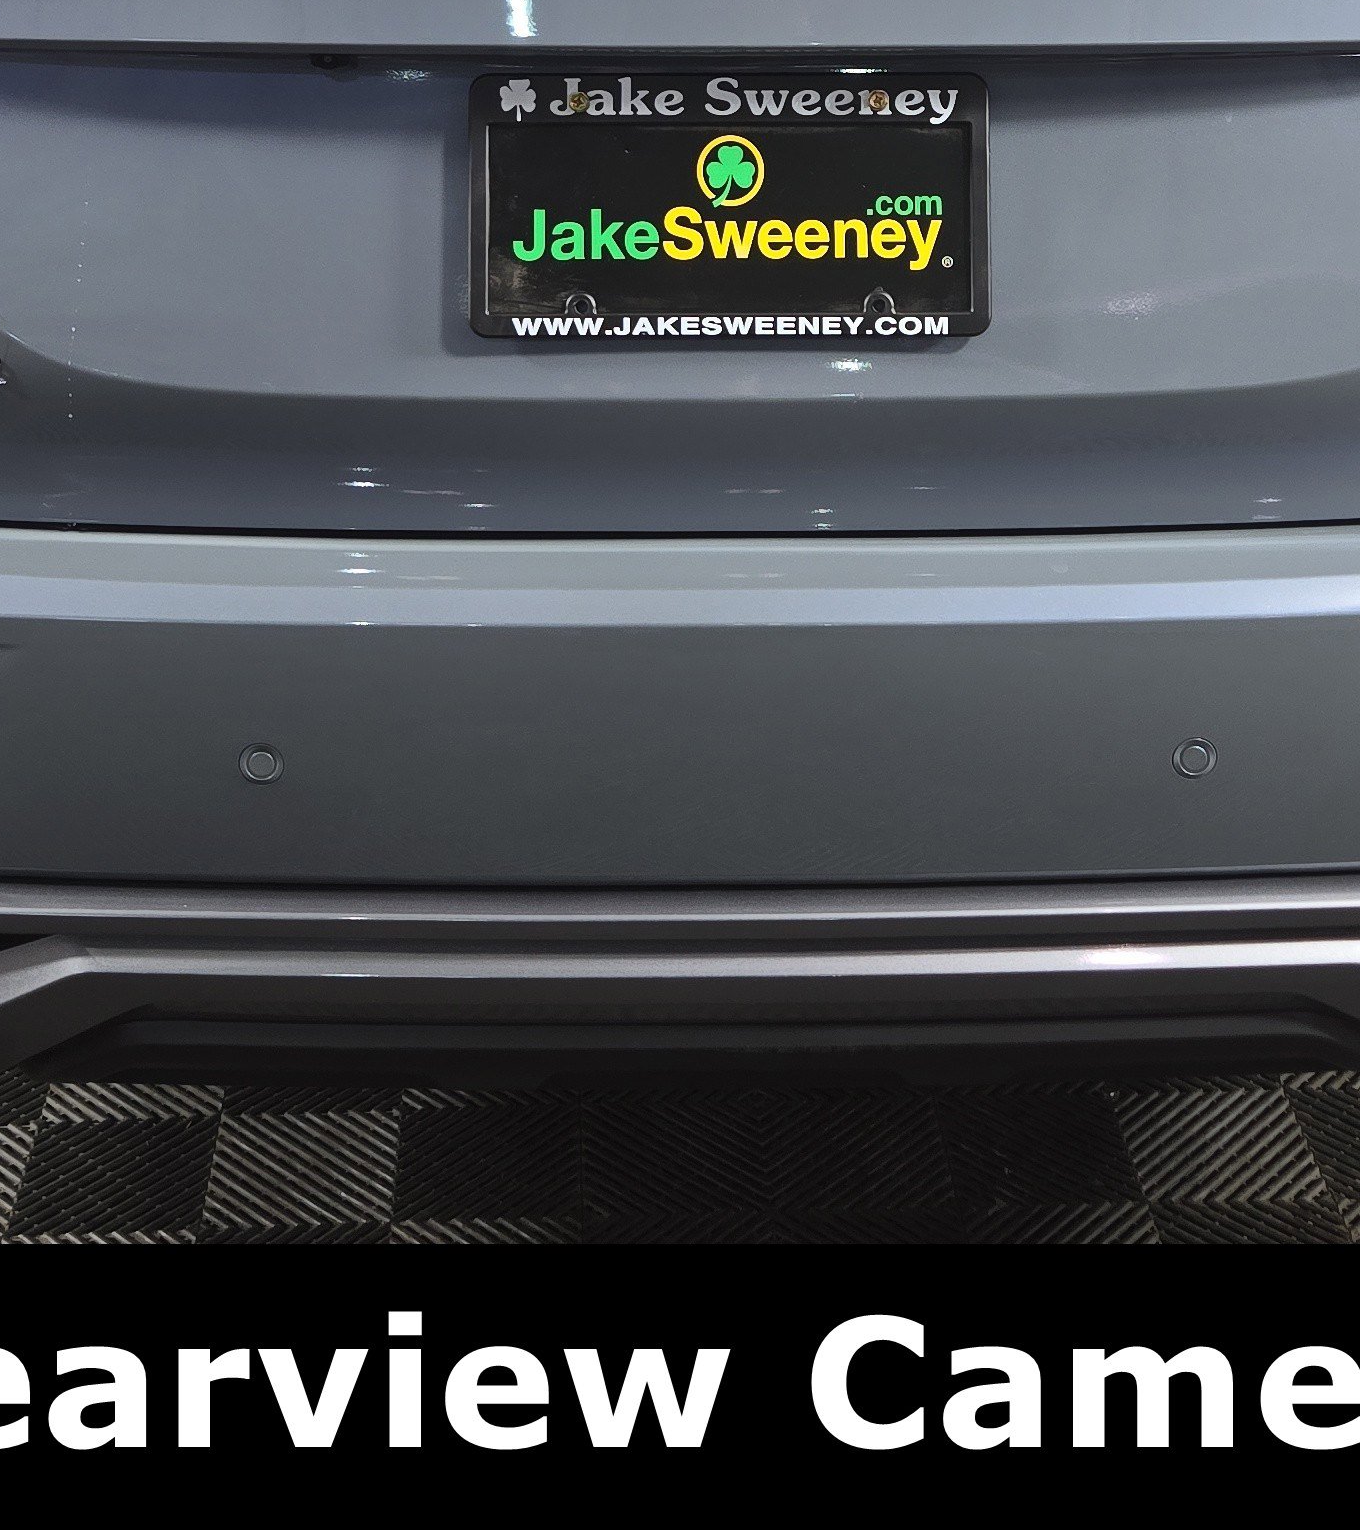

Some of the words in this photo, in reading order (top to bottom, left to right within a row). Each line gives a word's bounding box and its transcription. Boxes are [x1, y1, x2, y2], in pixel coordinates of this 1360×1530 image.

[549, 77, 685, 117] Jake
[704, 77, 959, 125] Sweeney
[866, 194, 943, 216] .com
[511, 316, 950, 337] WWW.JAKESWEENEY.COM
